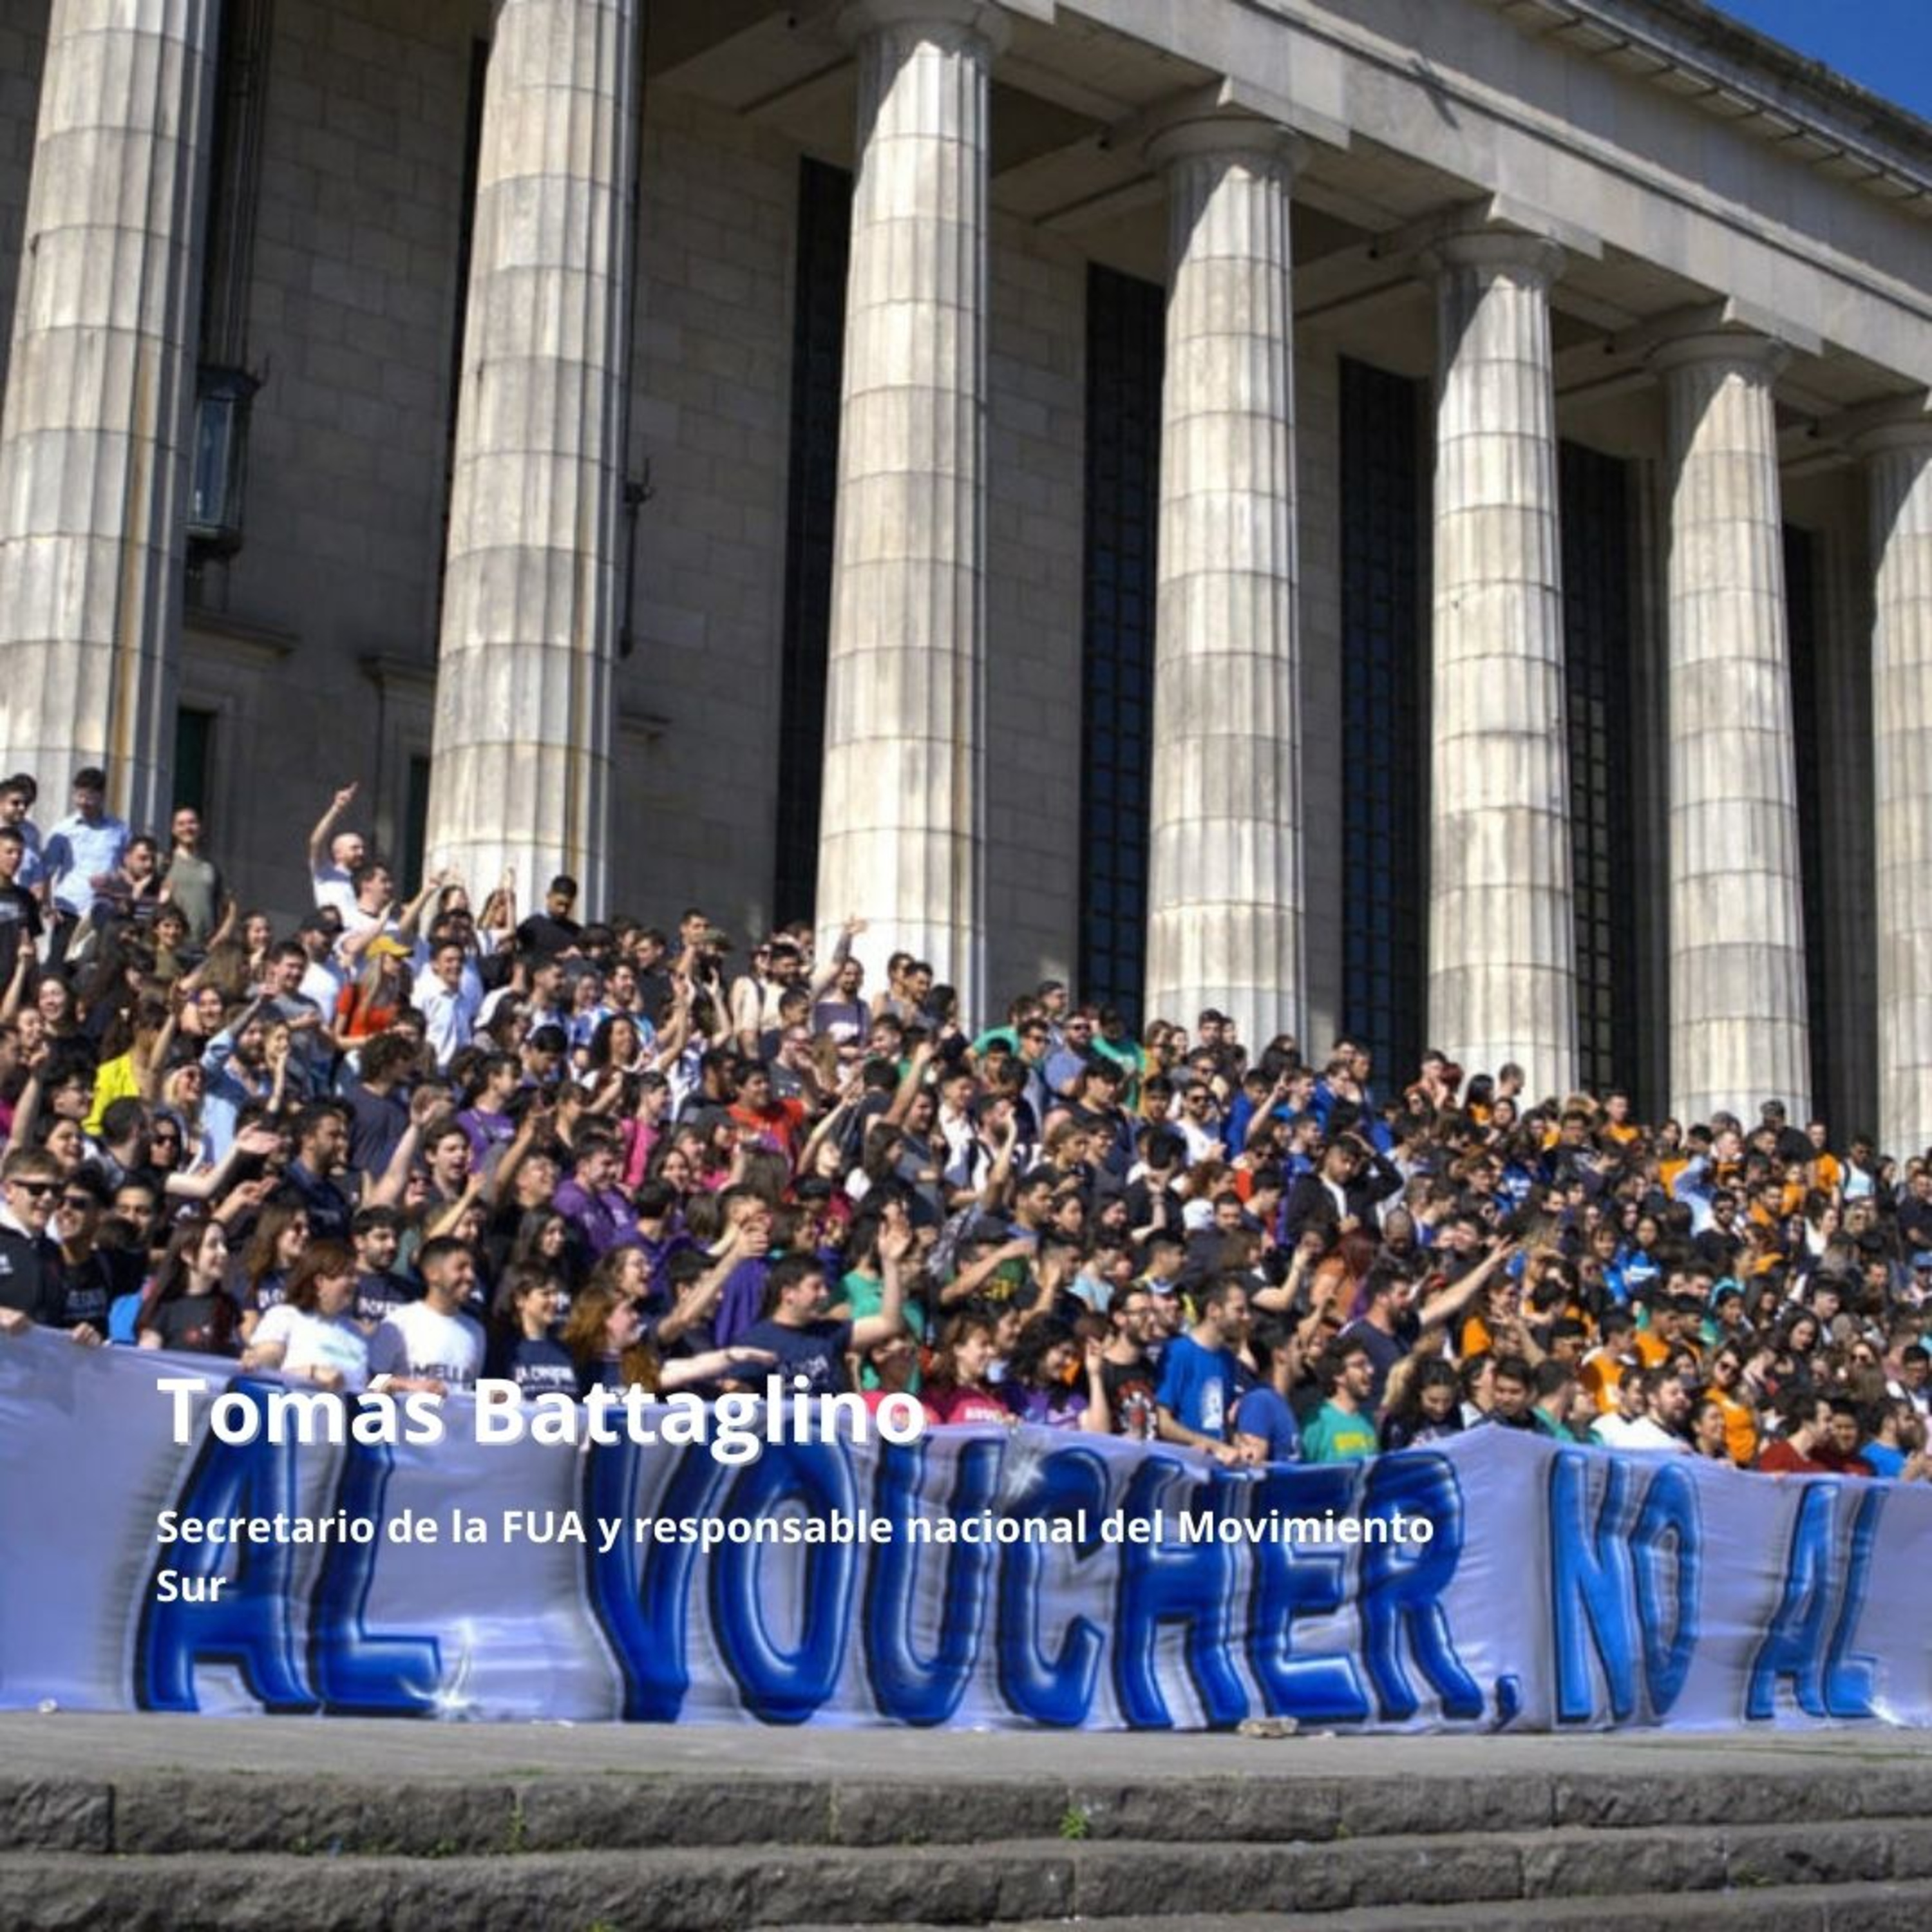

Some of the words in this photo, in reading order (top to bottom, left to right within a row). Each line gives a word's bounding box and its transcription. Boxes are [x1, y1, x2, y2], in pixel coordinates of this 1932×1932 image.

[134, 1376, 451, 1718] AL
[583, 1406, 1521, 1729] VOUCHER,
[1549, 1449, 1700, 1726] NO
[1745, 1481, 1889, 1720] AL
